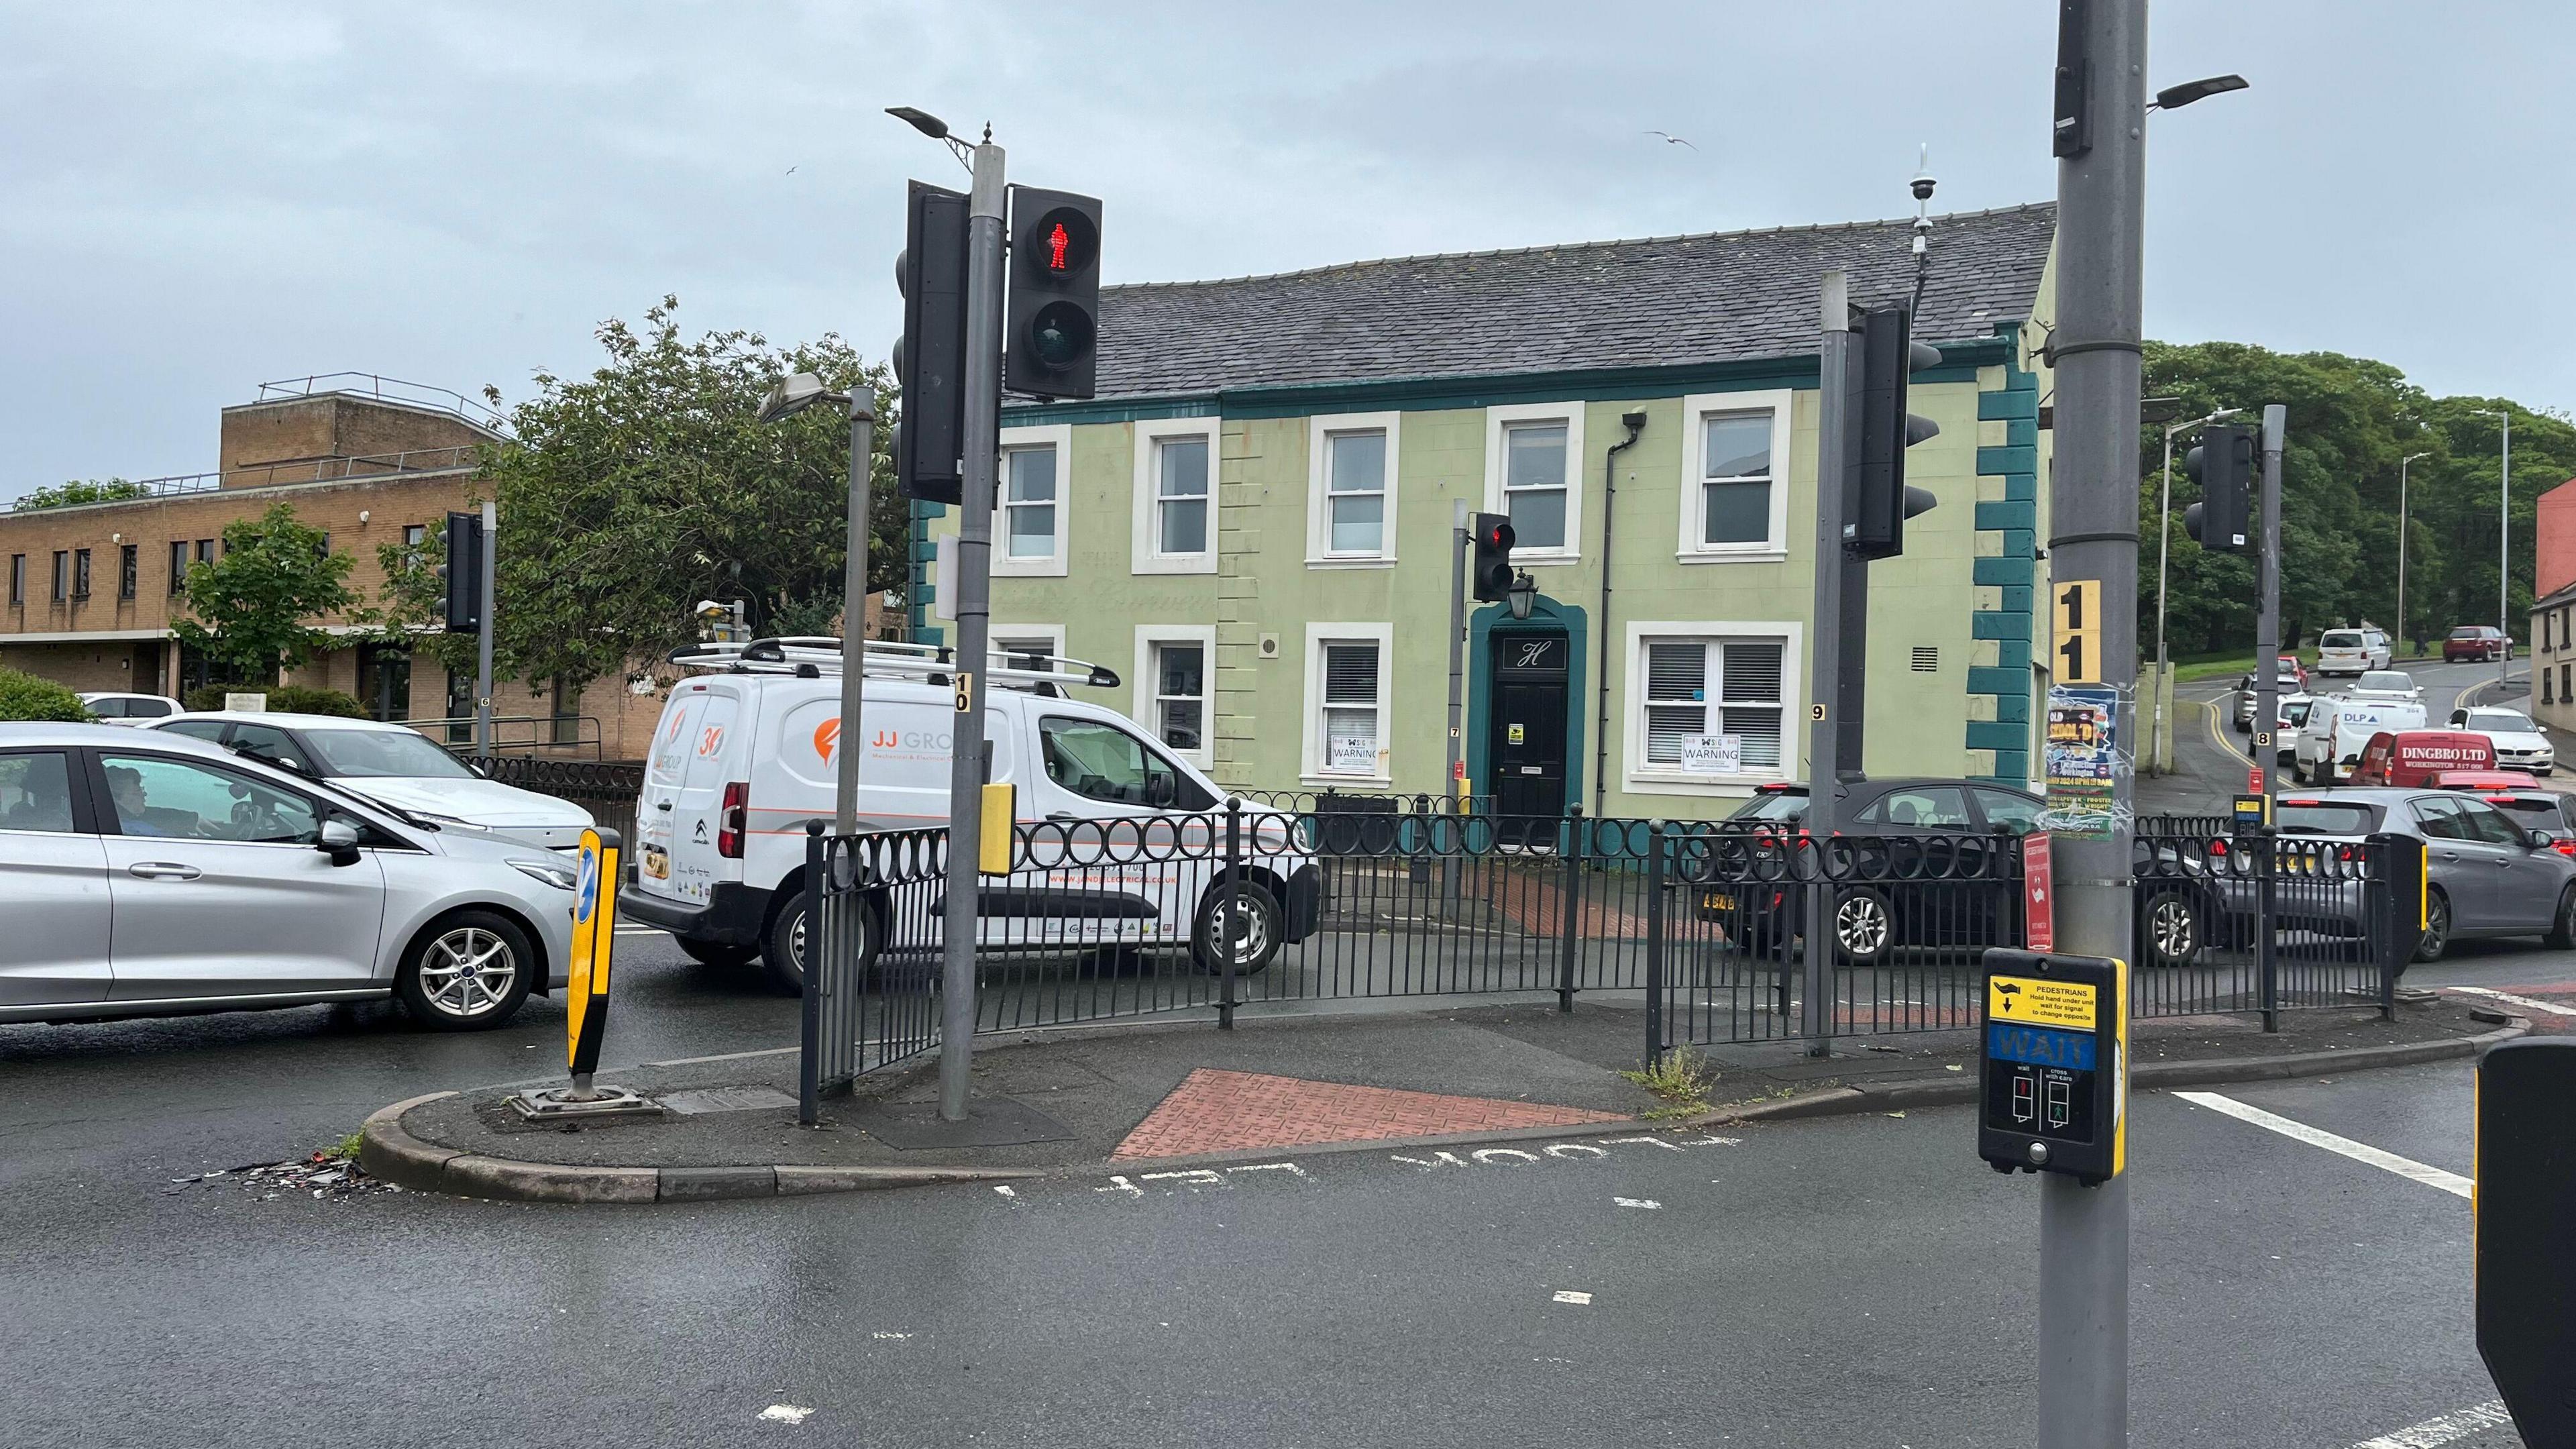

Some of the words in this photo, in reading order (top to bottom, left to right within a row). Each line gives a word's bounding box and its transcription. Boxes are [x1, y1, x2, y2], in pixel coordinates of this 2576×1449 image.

[1517, 640, 1552, 667] H
[1813, 705, 1823, 719] 9
[2049, 712, 2064, 722] OLD
[2344, 713, 2366, 722] DLP
[1452, 729, 1458, 737] 7
[2259, 733, 2268, 745] 8
[872, 730, 898, 747] JJ
[904, 732, 953, 749] GRO
[1684, 749, 1738, 759] WARNING
[2402, 747, 2460, 760] DINGBRO
[2463, 749, 2487, 761] LTD
[663, 755, 682, 769] GROUP
[2037, 985, 2088, 997] PEDESTRIANS
[2040, 1010, 2063, 1018] change
[2063, 1012, 2091, 1021] opposite
[1998, 1028, 2090, 1066] WAIT
